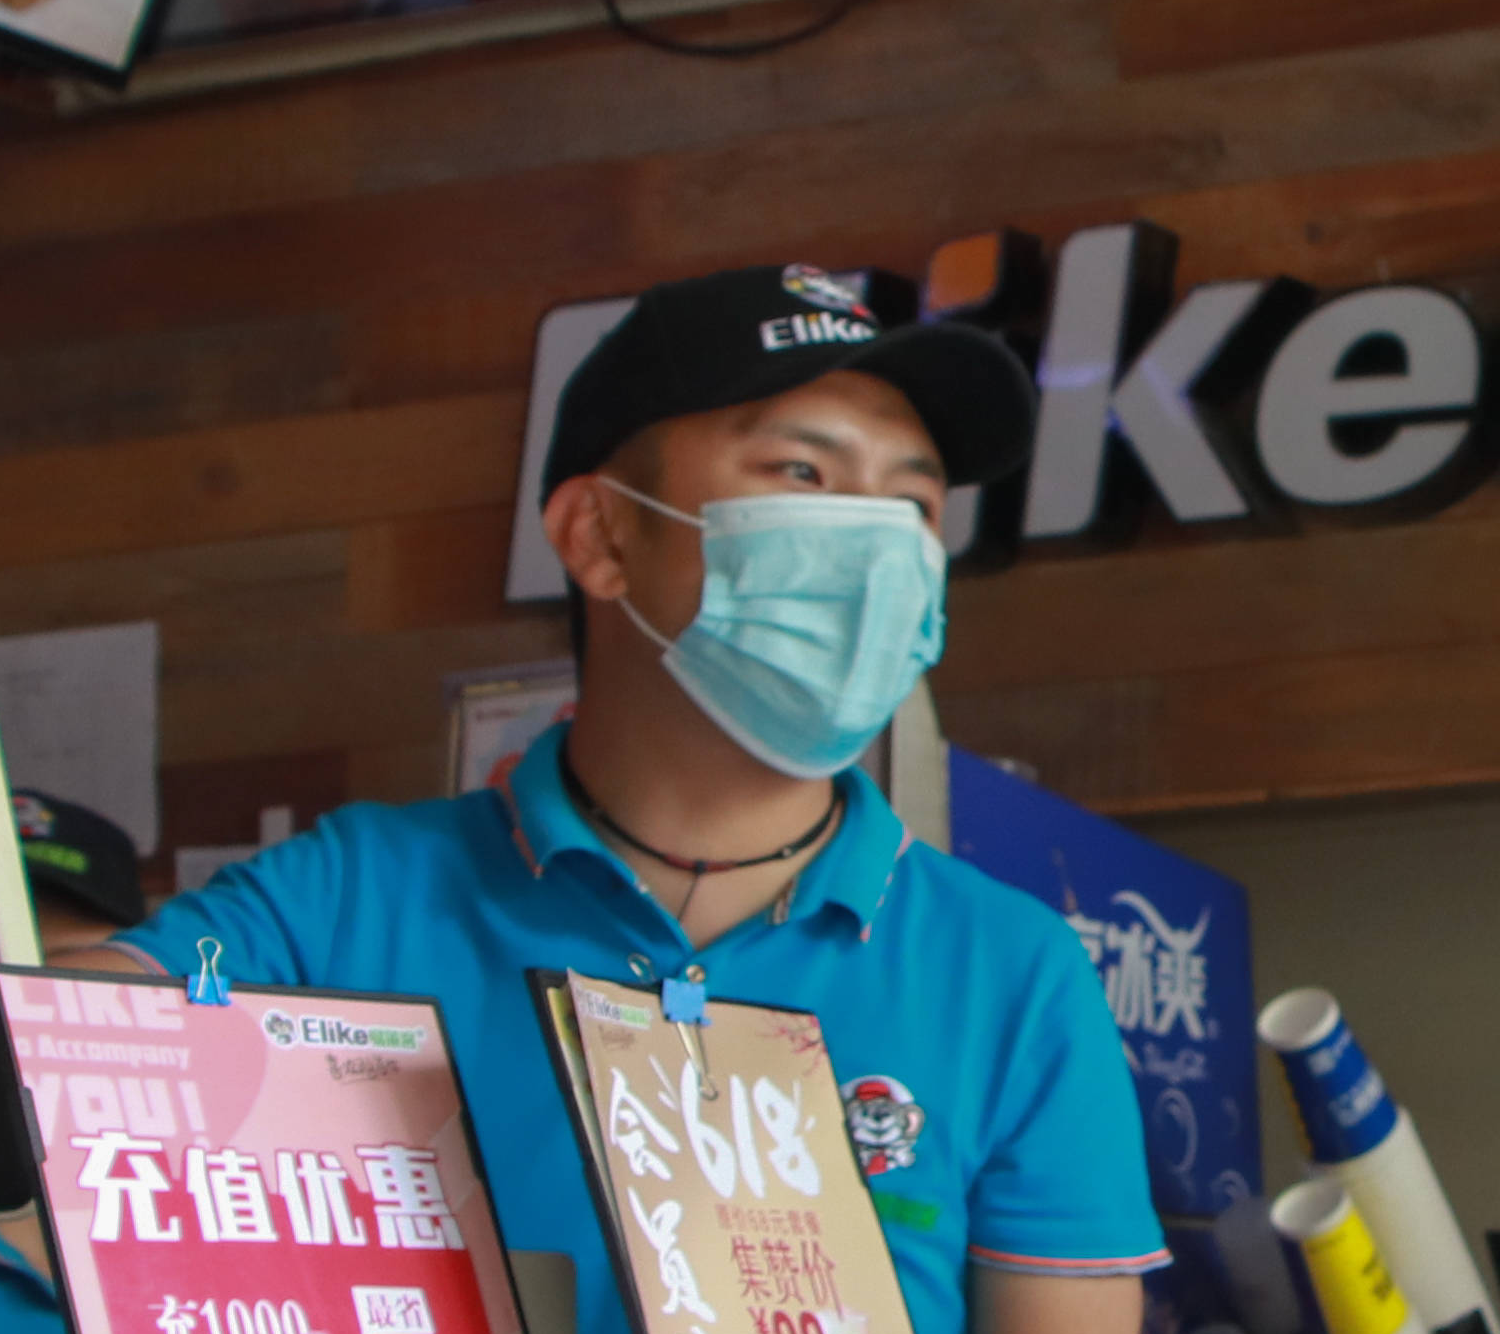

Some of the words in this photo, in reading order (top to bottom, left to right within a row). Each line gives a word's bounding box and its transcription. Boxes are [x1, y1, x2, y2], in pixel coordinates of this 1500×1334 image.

[301, 1017, 369, 1046] Elike
[680, 1058, 821, 1198] 618
[69, 1131, 467, 1251] 充值优惠
[366, 1293, 426, 1330] 最省
[730, 1233, 844, 1322] 集赞价
